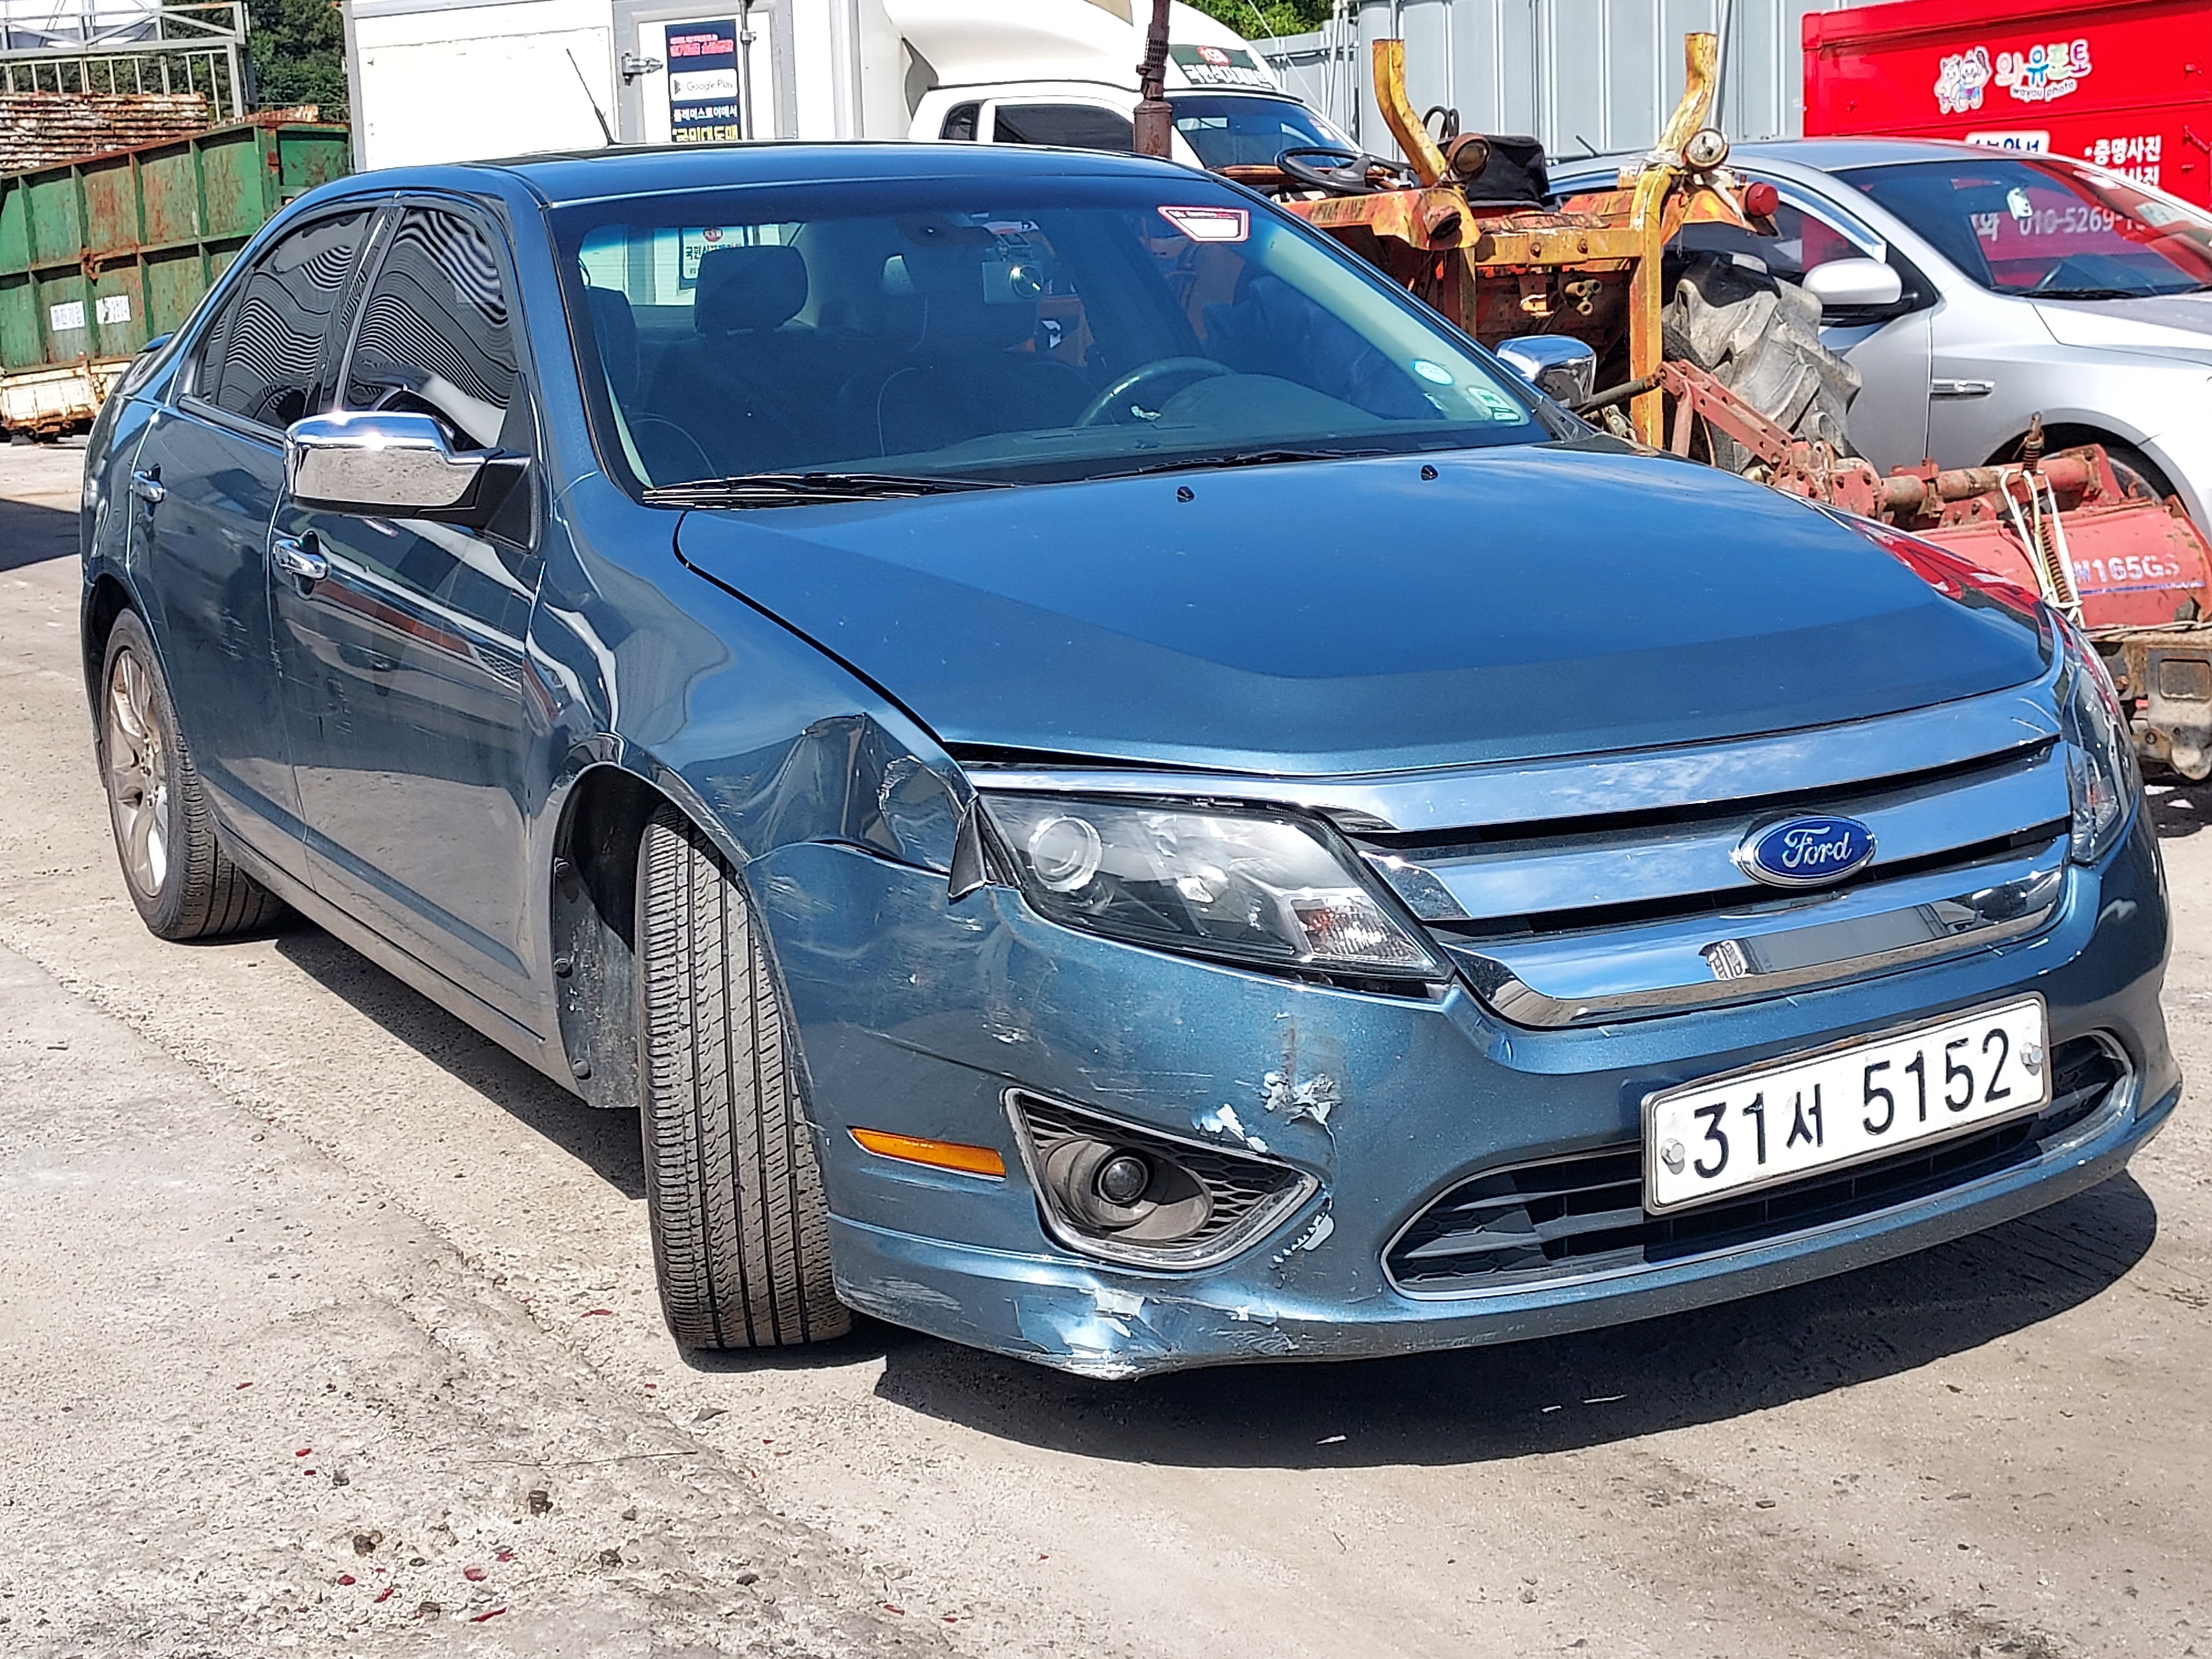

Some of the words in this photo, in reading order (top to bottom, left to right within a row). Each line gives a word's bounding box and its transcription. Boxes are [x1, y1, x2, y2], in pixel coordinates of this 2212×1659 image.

[1997, 43, 2089, 85] 와유포토
[687, 81, 714, 92] Google
[718, 79, 733, 89] Play
[2094, 135, 2162, 165] 증명사진
[1782, 826, 1853, 868] Ford
[1693, 1083, 1824, 1178] 31서
[1862, 1027, 2012, 1136] 5152
